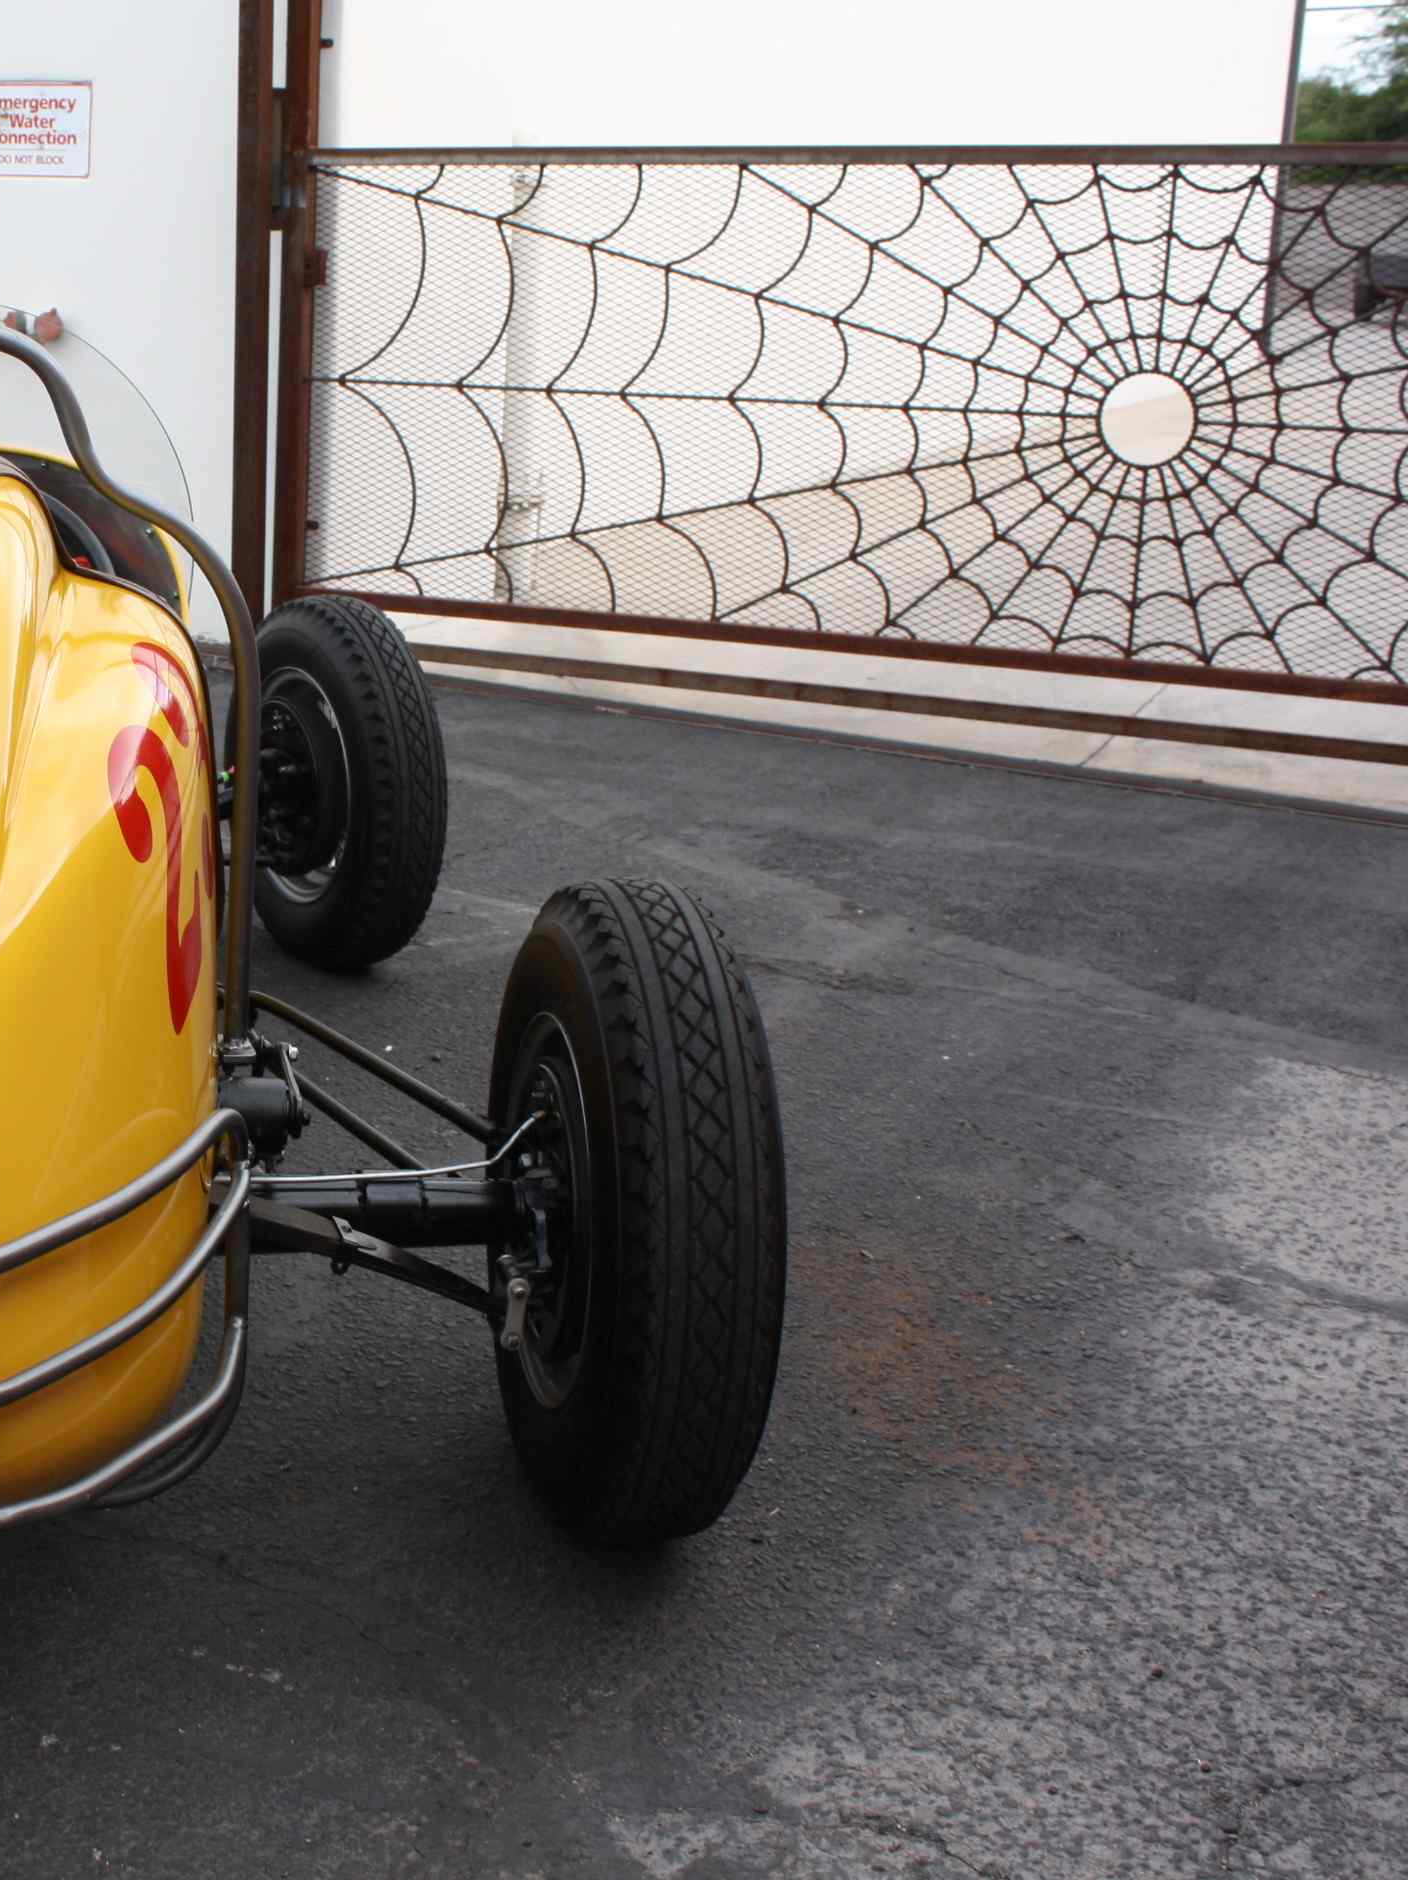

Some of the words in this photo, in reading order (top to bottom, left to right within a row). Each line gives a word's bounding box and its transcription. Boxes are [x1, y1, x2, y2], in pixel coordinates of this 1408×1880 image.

[9, 114, 56, 129] Water
[14, 155, 32, 164] NOT
[36, 155, 64, 165] BLOCK
